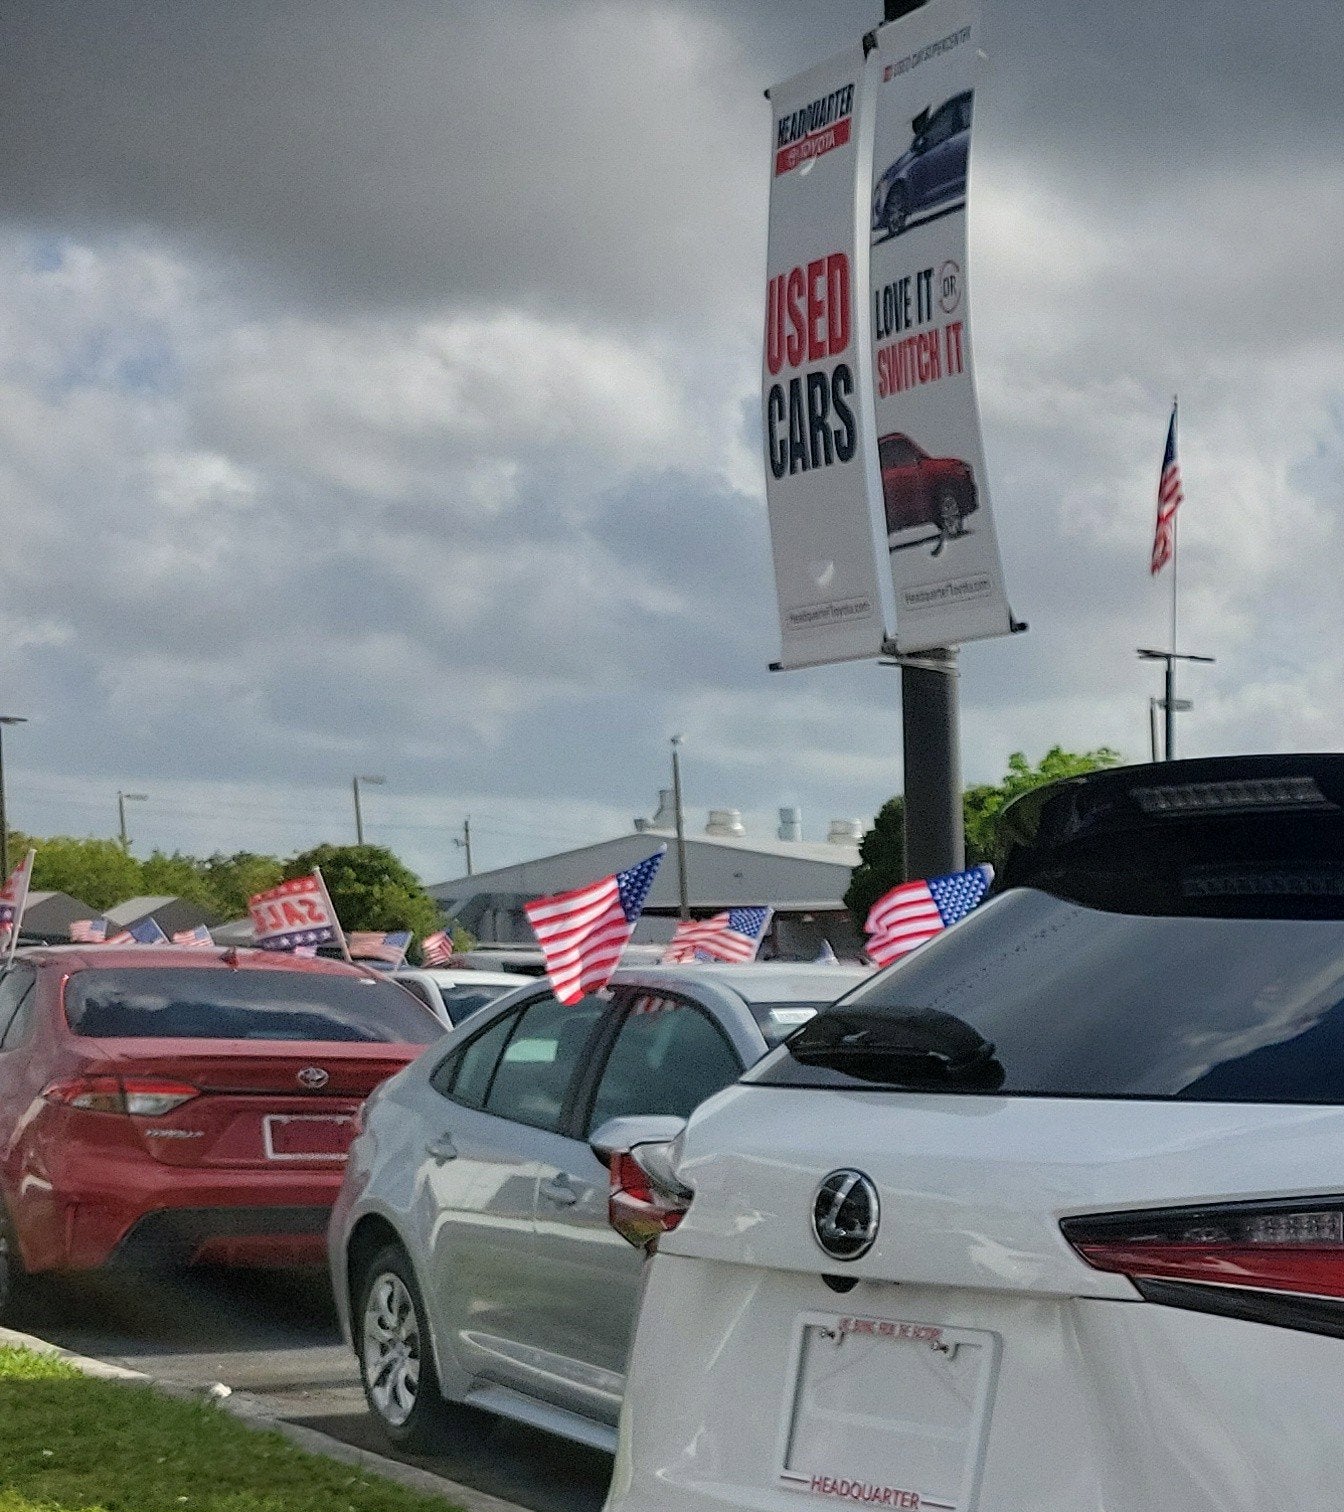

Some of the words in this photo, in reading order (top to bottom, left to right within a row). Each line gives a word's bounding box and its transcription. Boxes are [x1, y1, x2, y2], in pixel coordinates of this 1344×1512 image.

[777, 83, 855, 149] HEADQUARTER
[767, 253, 850, 375] USED
[875, 276, 911, 340] LOVE
[916, 268, 934, 323] IT
[942, 275, 957, 297] OR
[877, 329, 942, 399] SWITCH
[946, 321, 963, 376] IT
[768, 363, 857, 480] CARS
[810, 1474, 920, 1510] HEADQUARTER
